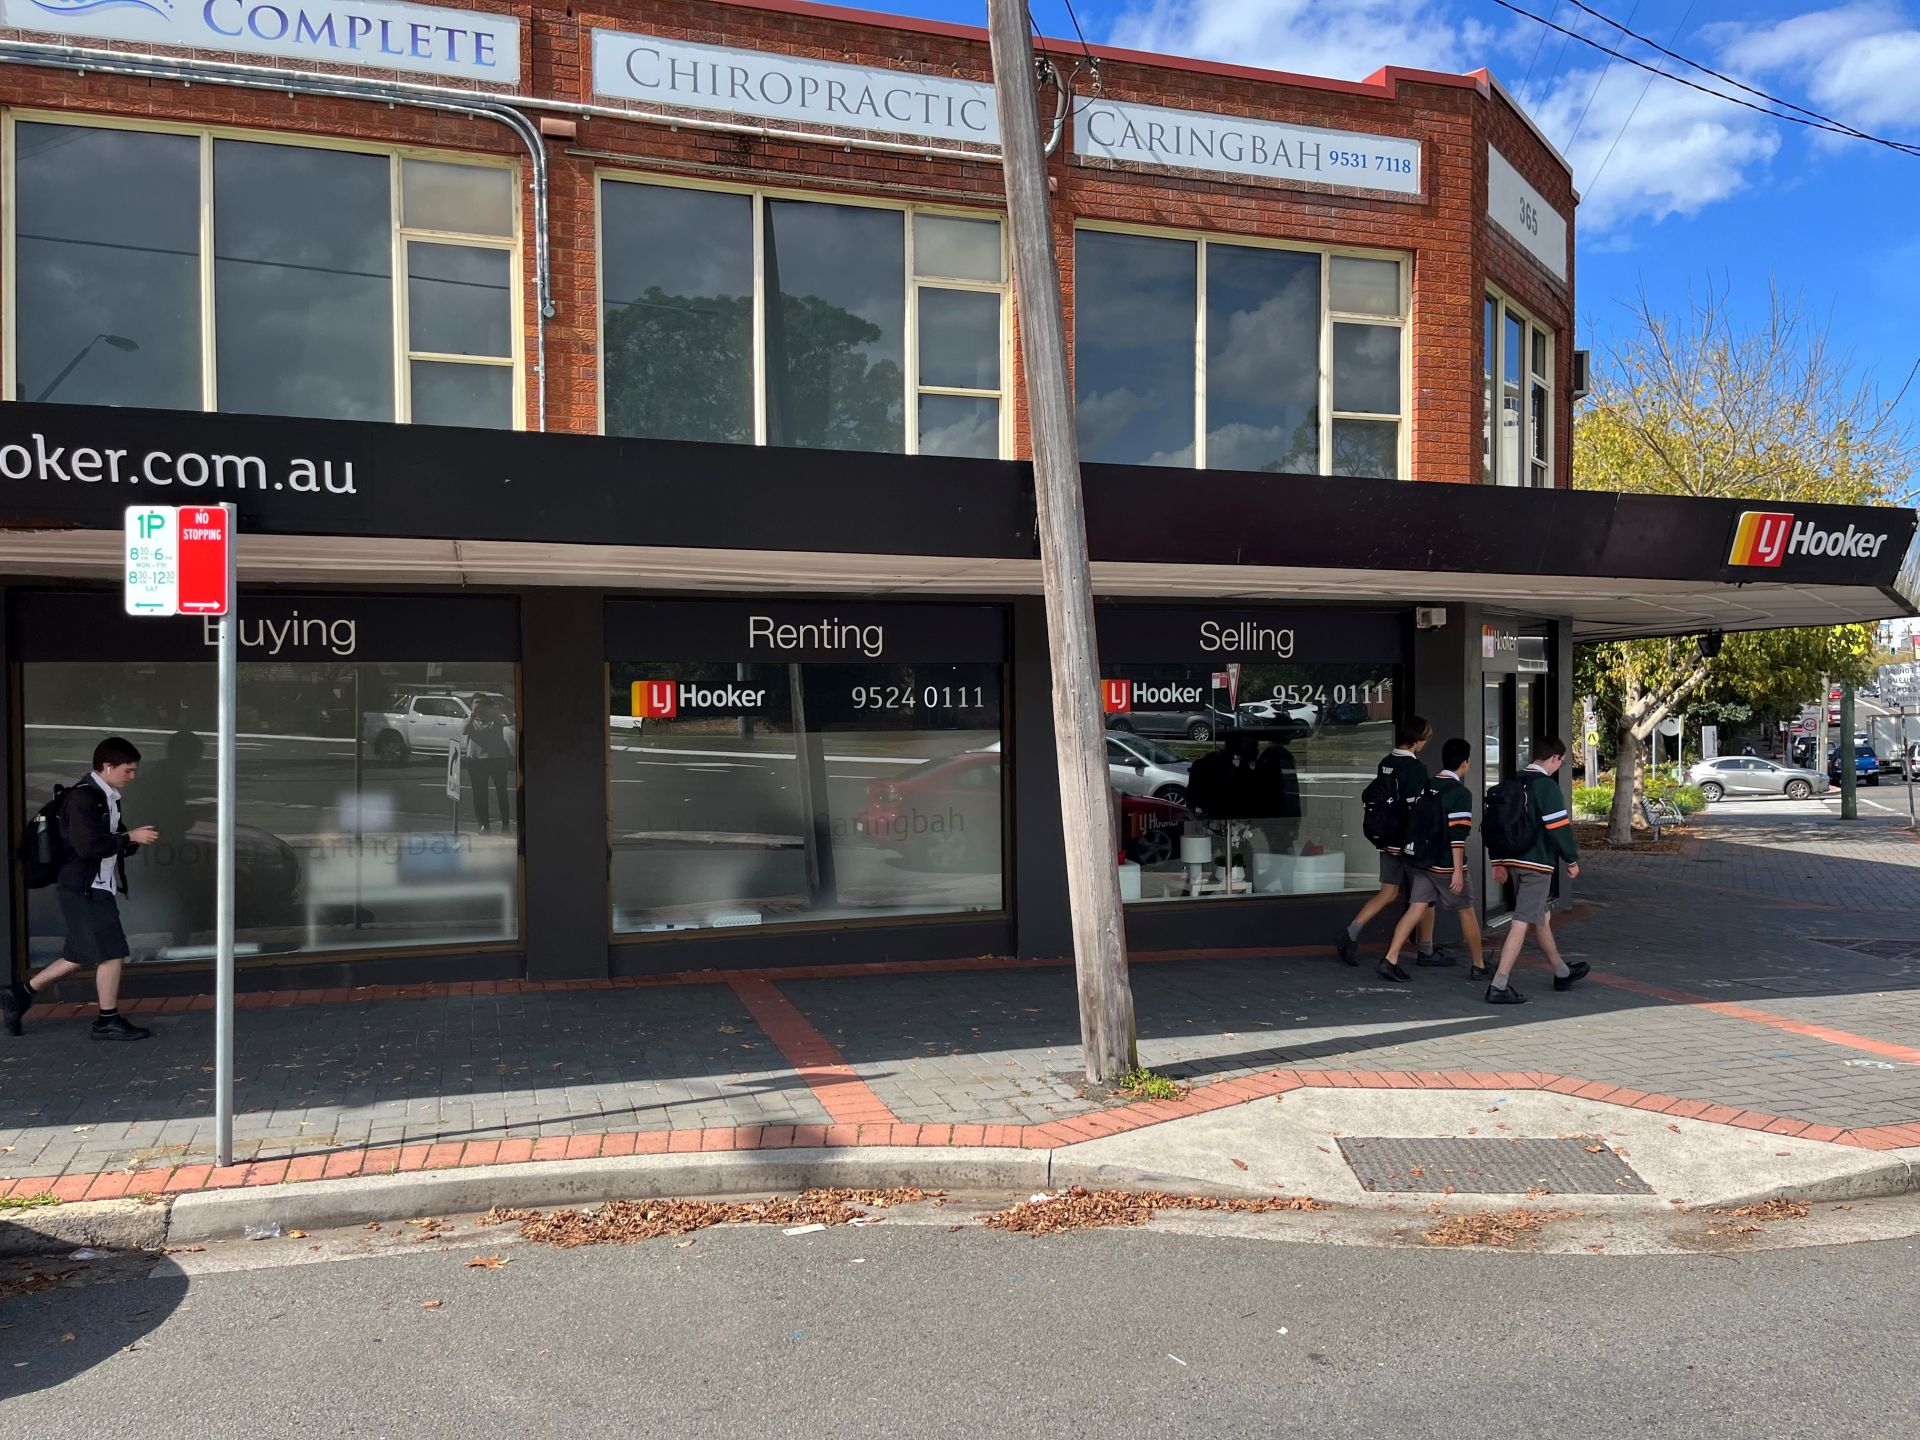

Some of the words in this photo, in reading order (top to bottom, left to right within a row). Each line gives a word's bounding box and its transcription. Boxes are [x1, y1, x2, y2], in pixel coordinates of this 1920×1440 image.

[203, 0, 496, 67] COMPLETE
[626, 48, 987, 131] CHIROPRACTIC
[1087, 111, 1323, 172] CARINGBAH
[1329, 150, 1367, 169] 9531
[1375, 155, 1411, 174] 7118
[1519, 196, 1538, 236] 365
[0, 433, 357, 494] oker.com.au
[137, 514, 165, 539] 1P
[183, 528, 222, 541] STOPPING
[195, 512, 209, 524] NO
[1758, 519, 1786, 563] LJ
[1787, 521, 1888, 558] Hooker
[749, 616, 883, 657] Renting
[1200, 621, 1294, 658] Selling
[652, 684, 671, 714] LJ
[679, 684, 765, 708] Hooker
[852, 686, 916, 709] 9524
[923, 686, 984, 708] 0111
[1111, 682, 1126, 709] LJ
[1133, 682, 1202, 704] Hooker
[1273, 685, 1326, 705] 9524
[1333, 684, 1385, 705] 0111
